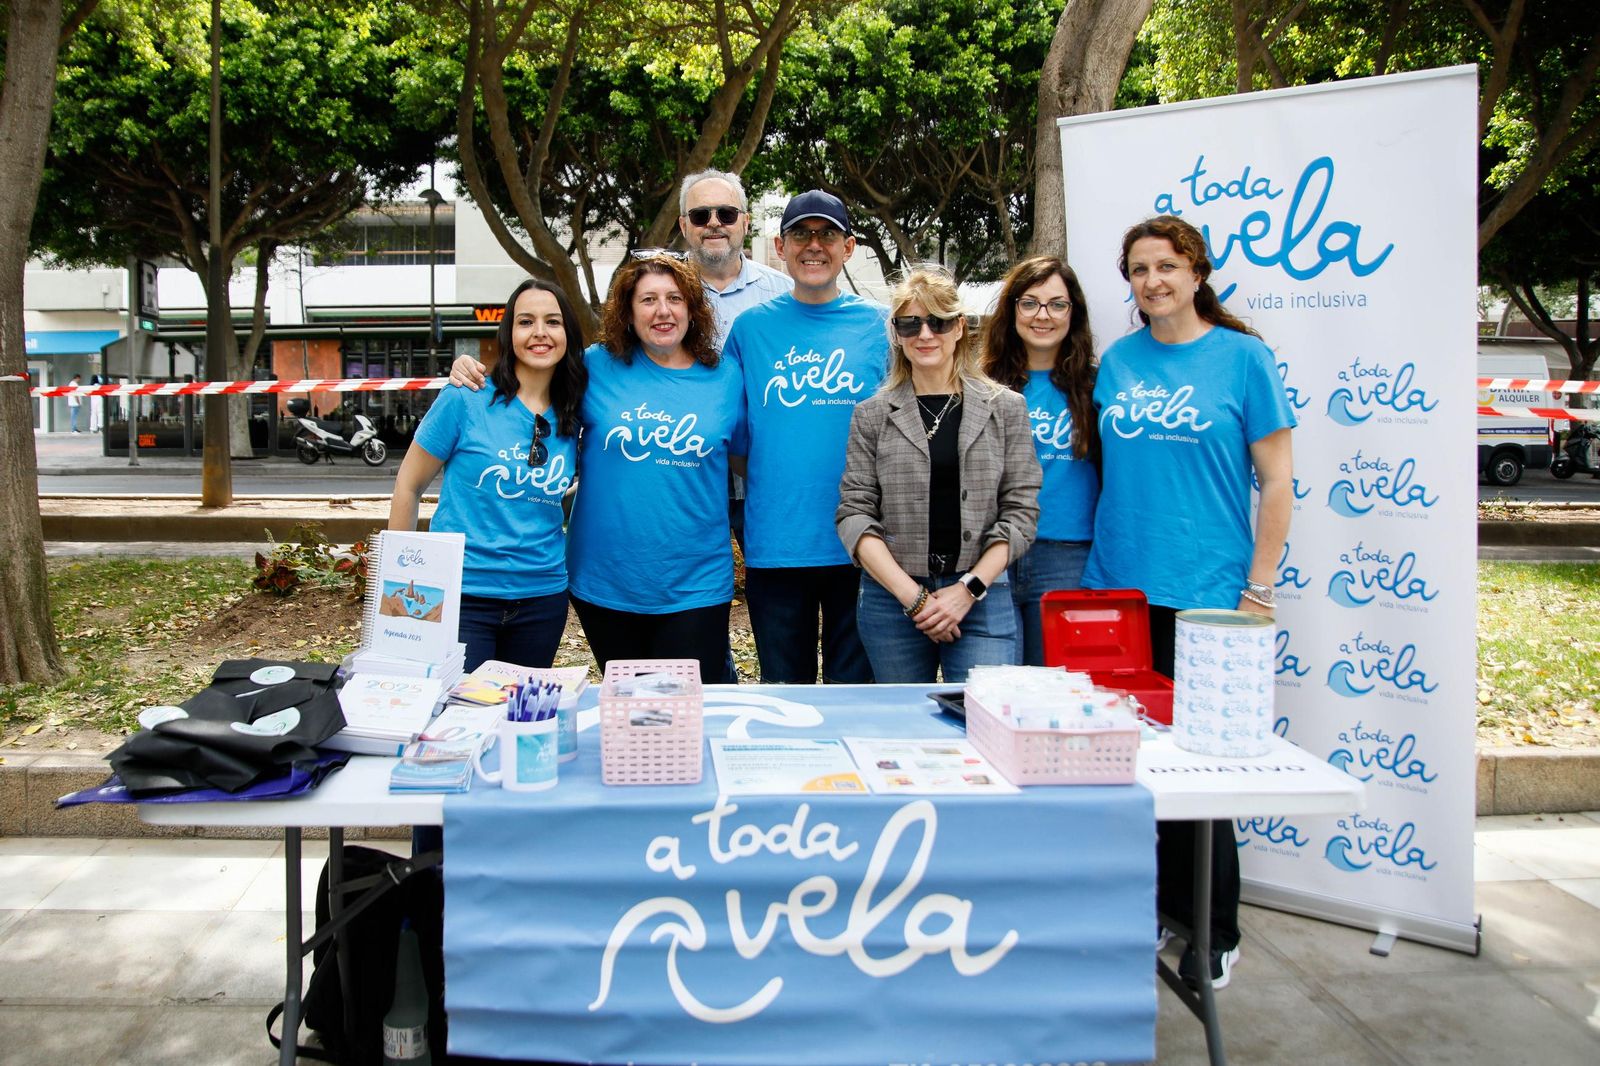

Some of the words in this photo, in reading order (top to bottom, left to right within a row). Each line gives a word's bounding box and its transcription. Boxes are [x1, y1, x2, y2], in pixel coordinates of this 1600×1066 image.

[1154, 192, 1182, 216] a
[1180, 154, 1284, 207] toda
[1202, 155, 1395, 280] vela
[1247, 292, 1284, 310] vida
[1290, 290, 1368, 309] inclusiva
[774, 360, 786, 371] a
[784, 345, 826, 366] toda
[1338, 370, 1350, 381] a
[1350, 356, 1393, 378] toda
[791, 348, 864, 394] vela
[1116, 391, 1128, 401] a
[1130, 380, 1171, 399] toda
[1358, 362, 1440, 412] vela
[1498, 394, 1540, 403] ALQUILER
[621, 411, 633, 422] a
[634, 402, 677, 424] toda
[827, 397, 857, 405] inclusiva
[1130, 385, 1212, 432] vela
[1395, 417, 1429, 425] inclusiva
[638, 413, 714, 458] vela
[1148, 433, 1164, 441] vida
[1165, 434, 1199, 444] inclusiva
[498, 449, 511, 461] a
[655, 458, 670, 466] vida
[671, 459, 701, 468] inclusiva
[1339, 463, 1352, 474] a
[1351, 449, 1394, 472] toda
[1360, 458, 1440, 508] vela
[1395, 511, 1429, 520] inclusiva
[1339, 552, 1352, 565] a
[1352, 541, 1394, 565] toda
[1361, 551, 1440, 602] vela
[1378, 600, 1394, 609] vida
[1396, 603, 1429, 614] inclusiva
[1339, 642, 1352, 655] a
[1352, 631, 1394, 656] toda
[1361, 643, 1439, 693] vela
[366, 679, 423, 694] 2025
[1378, 690, 1394, 699] vida
[1396, 692, 1428, 705] inclusiva
[1338, 731, 1350, 744] a
[1351, 720, 1395, 745] toda
[1360, 733, 1438, 783] vela
[1377, 778, 1394, 788] vida
[1396, 781, 1428, 795] inclusiva
[1337, 819, 1350, 831] a
[1350, 812, 1393, 832] toda
[645, 835, 697, 879] a
[691, 796, 860, 863] toda
[1358, 822, 1438, 871] vela
[1376, 867, 1392, 876] vida
[1394, 869, 1428, 882] inclusiva
[725, 799, 1019, 977] vela
